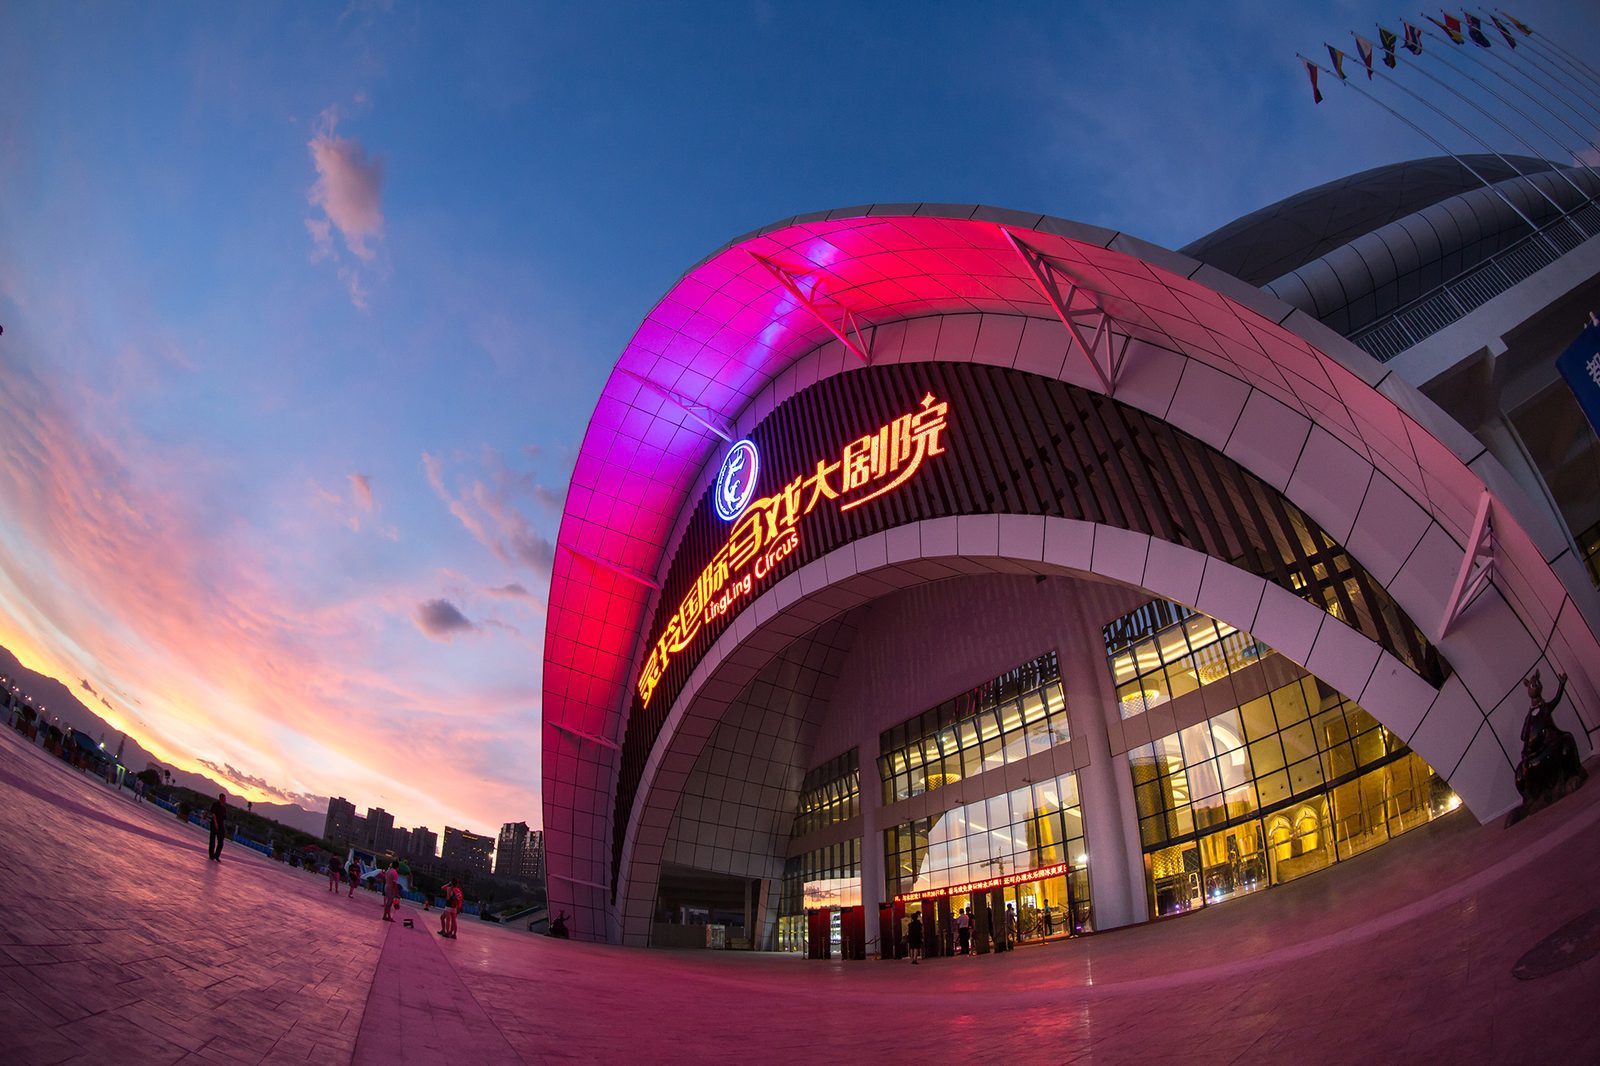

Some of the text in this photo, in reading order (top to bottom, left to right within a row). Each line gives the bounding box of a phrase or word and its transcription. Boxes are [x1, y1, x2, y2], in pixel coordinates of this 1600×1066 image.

[638, 392, 948, 709] 灵玲国际马戏大剧院
[704, 528, 799, 624] LingLing Circus
